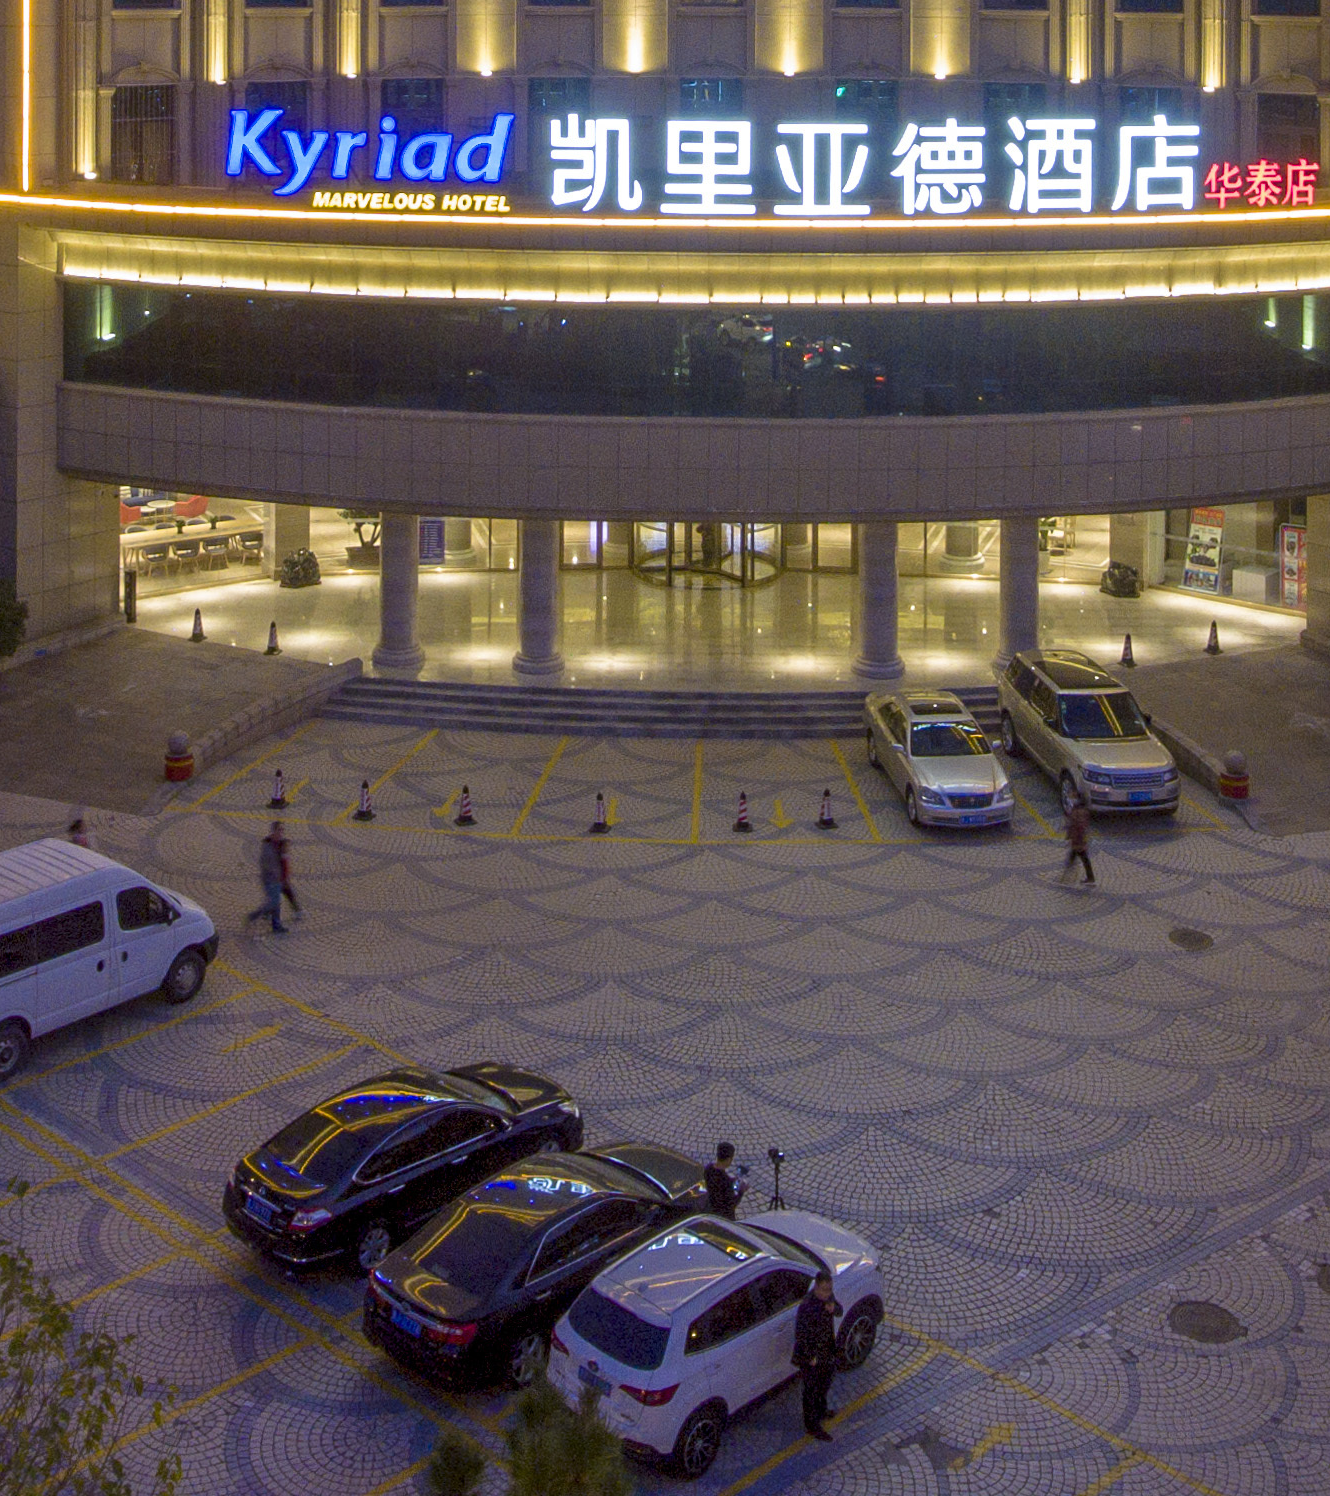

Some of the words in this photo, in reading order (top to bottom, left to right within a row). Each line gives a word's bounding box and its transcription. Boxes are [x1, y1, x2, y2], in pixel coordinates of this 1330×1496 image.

[225, 107, 516, 196] Kyriad
[548, 112, 1202, 215] 凯里亚德酒店
[1202, 157, 1320, 209] 华泰店
[312, 191, 436, 210] MARVELOUS
[441, 194, 511, 213] HOTEL
